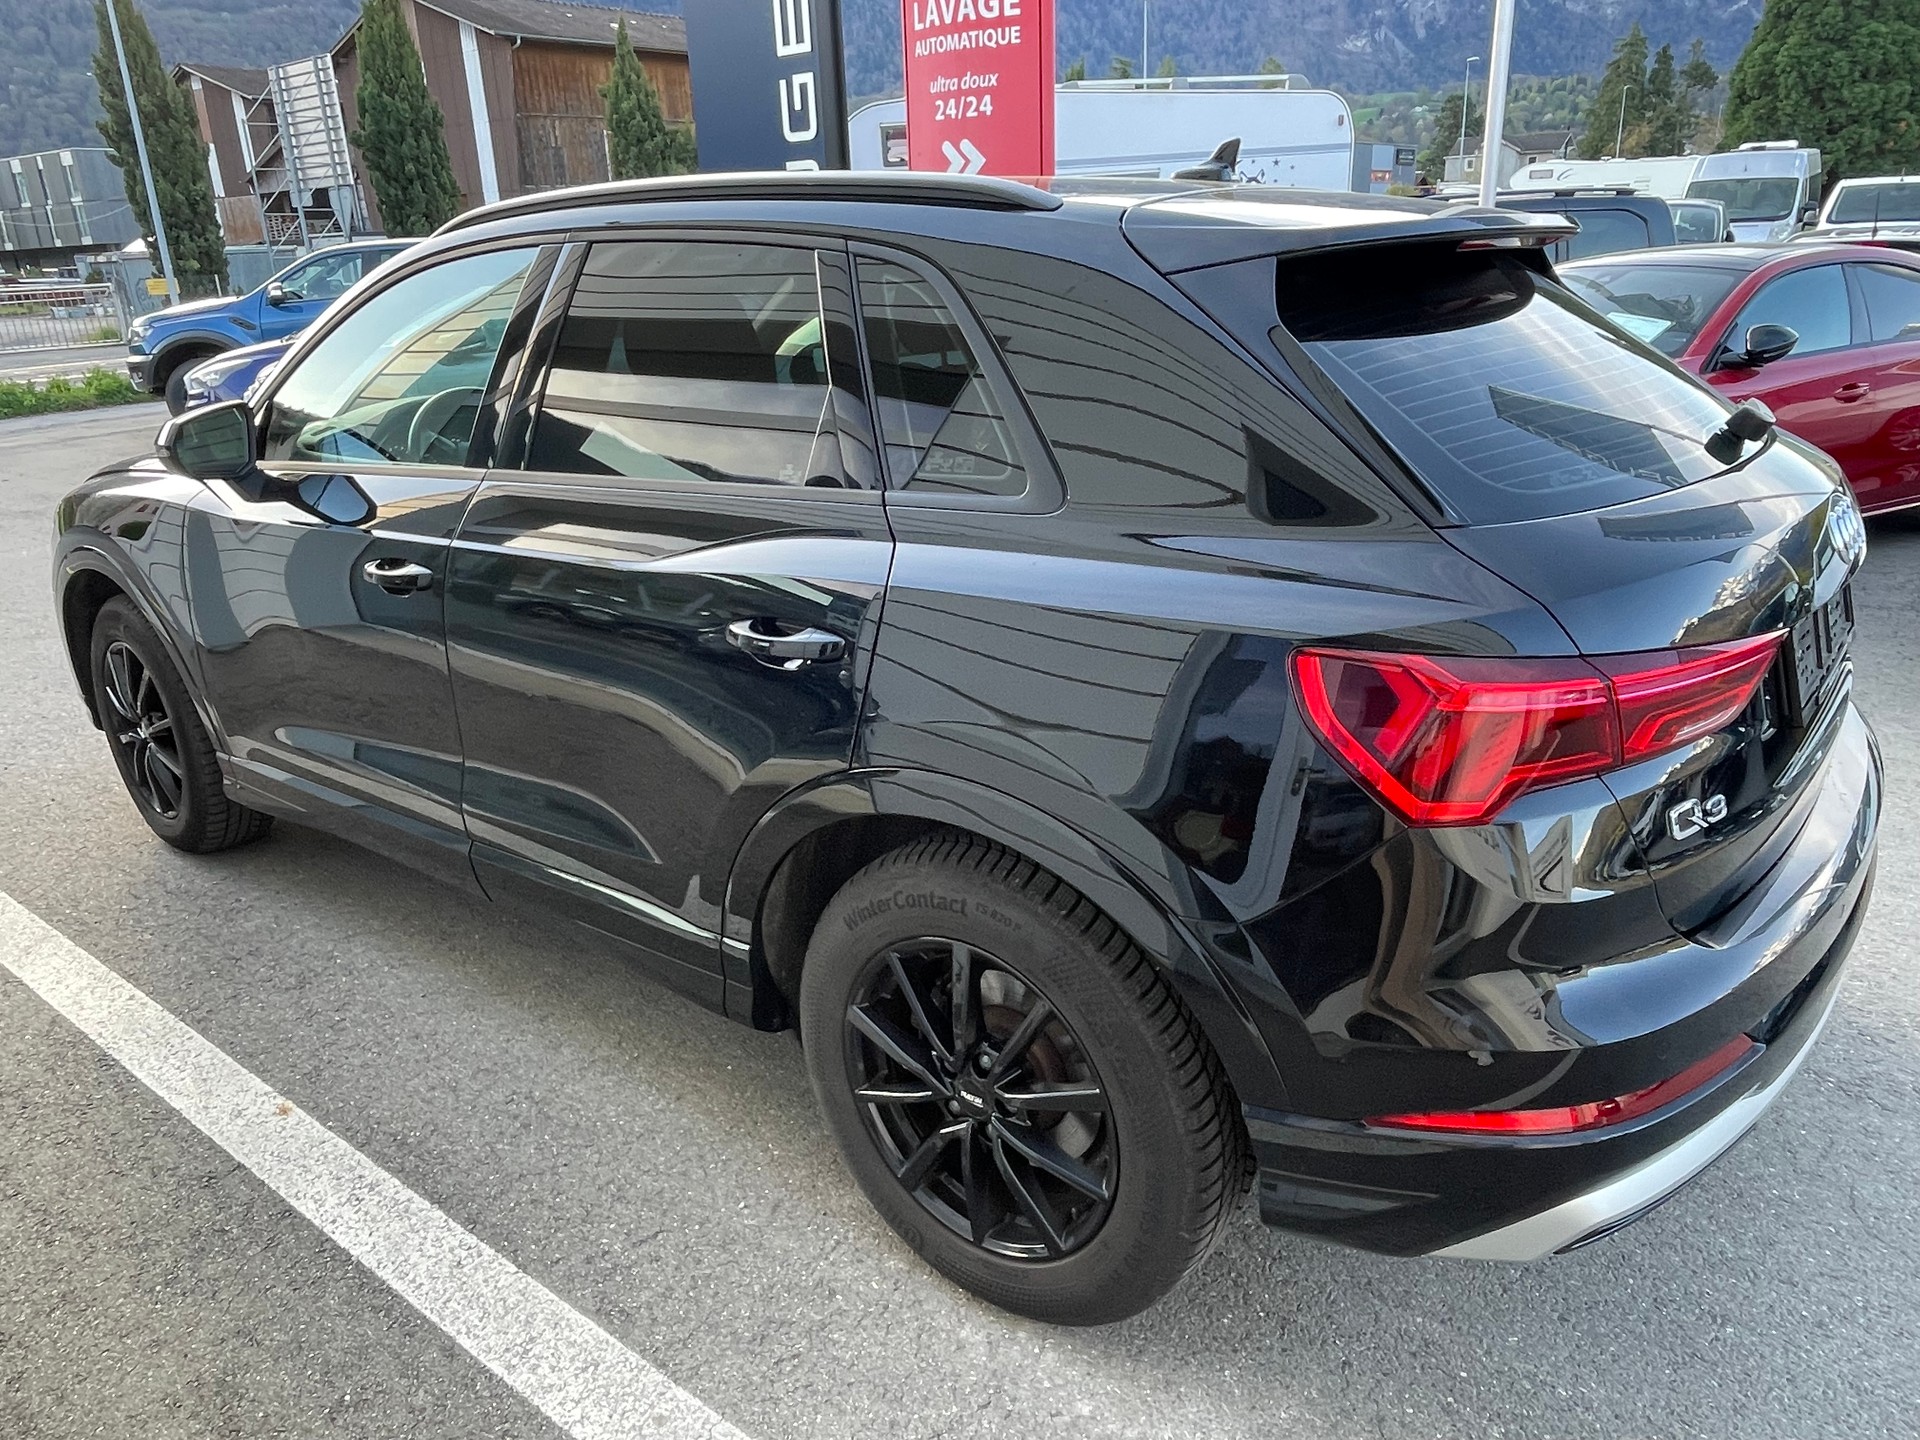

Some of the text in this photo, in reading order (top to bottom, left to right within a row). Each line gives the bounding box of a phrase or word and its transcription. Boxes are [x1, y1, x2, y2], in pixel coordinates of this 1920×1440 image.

[914, 0, 1021, 31] LAVAGE
[915, 26, 1021, 58] AUTOMATIQUE
[773, 0, 820, 171] GE
[930, 71, 999, 94] ultra doux
[935, 94, 993, 121] 24/24
[842, 890, 969, 931] WinterContact
